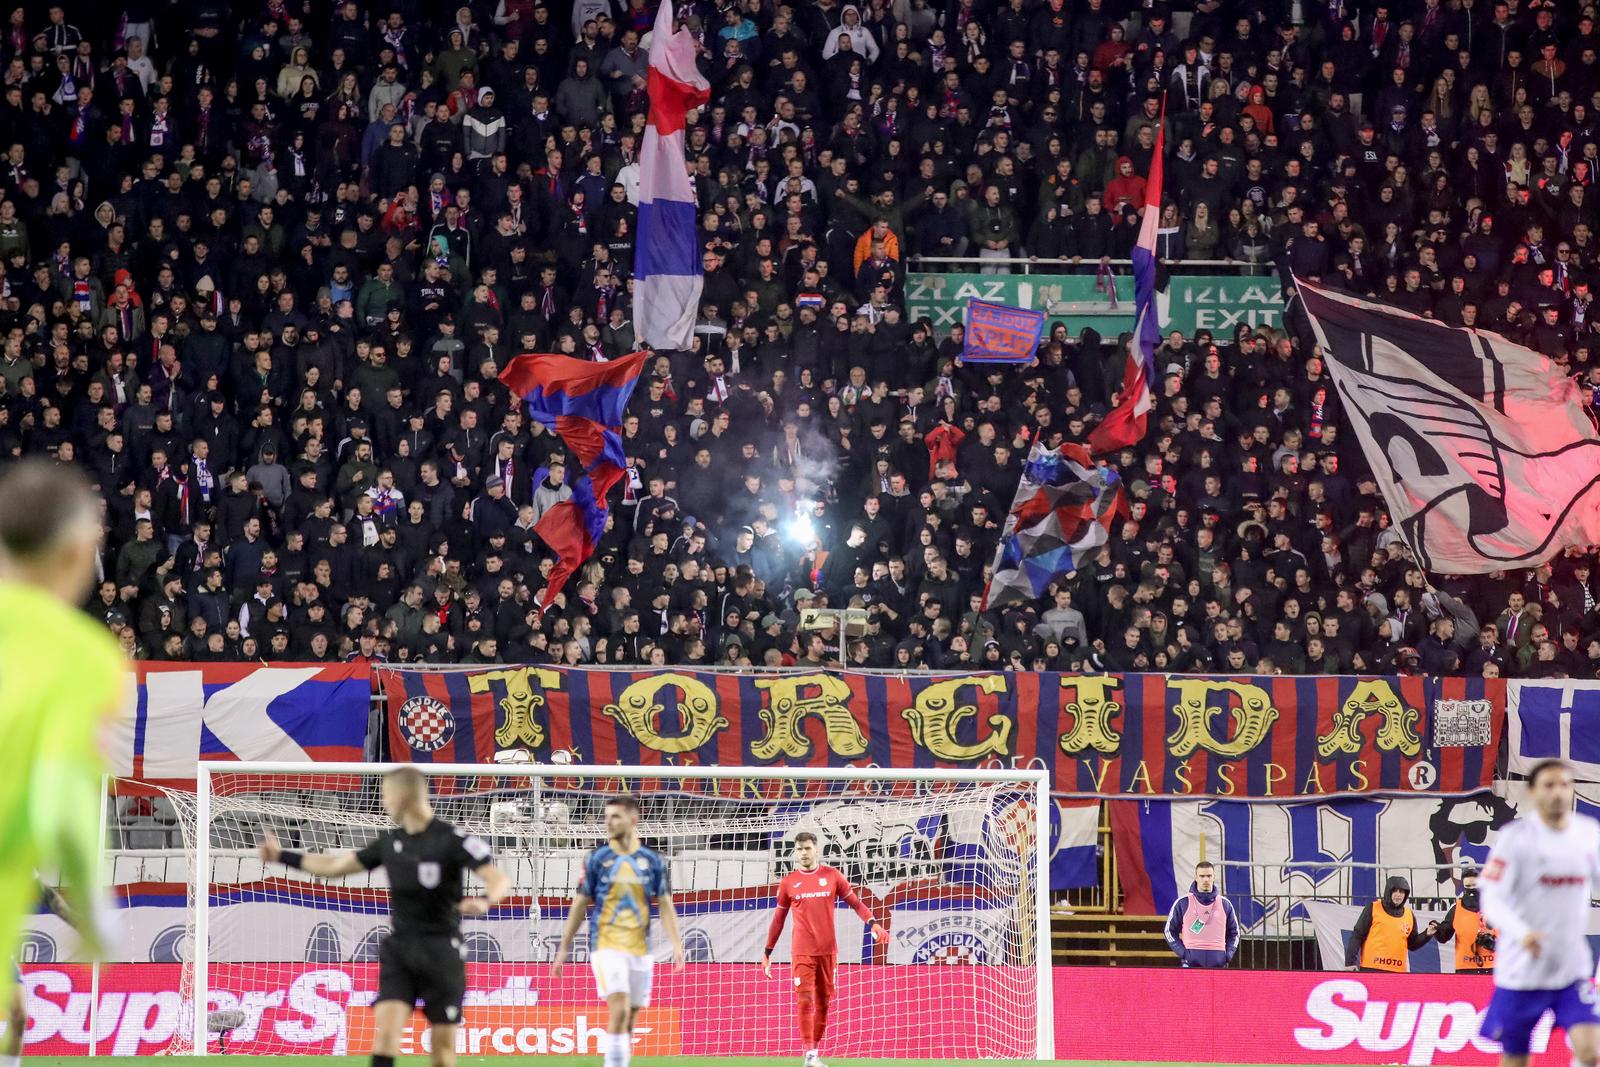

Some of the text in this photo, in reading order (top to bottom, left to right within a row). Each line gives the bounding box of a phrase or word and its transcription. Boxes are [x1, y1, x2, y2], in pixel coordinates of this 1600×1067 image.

[909, 281, 1005, 301] ZLAZ
[1184, 284, 1285, 304] IZLAZ
[911, 306, 967, 326] EXI
[1196, 309, 1279, 330] EXIT
[402, 697, 448, 716] HAJDUK
[408, 736, 445, 750] SPLIT
[801, 891, 831, 899] FAVBET
[1373, 957, 1403, 967] PHOTO
[1463, 954, 1495, 964] PHTO
